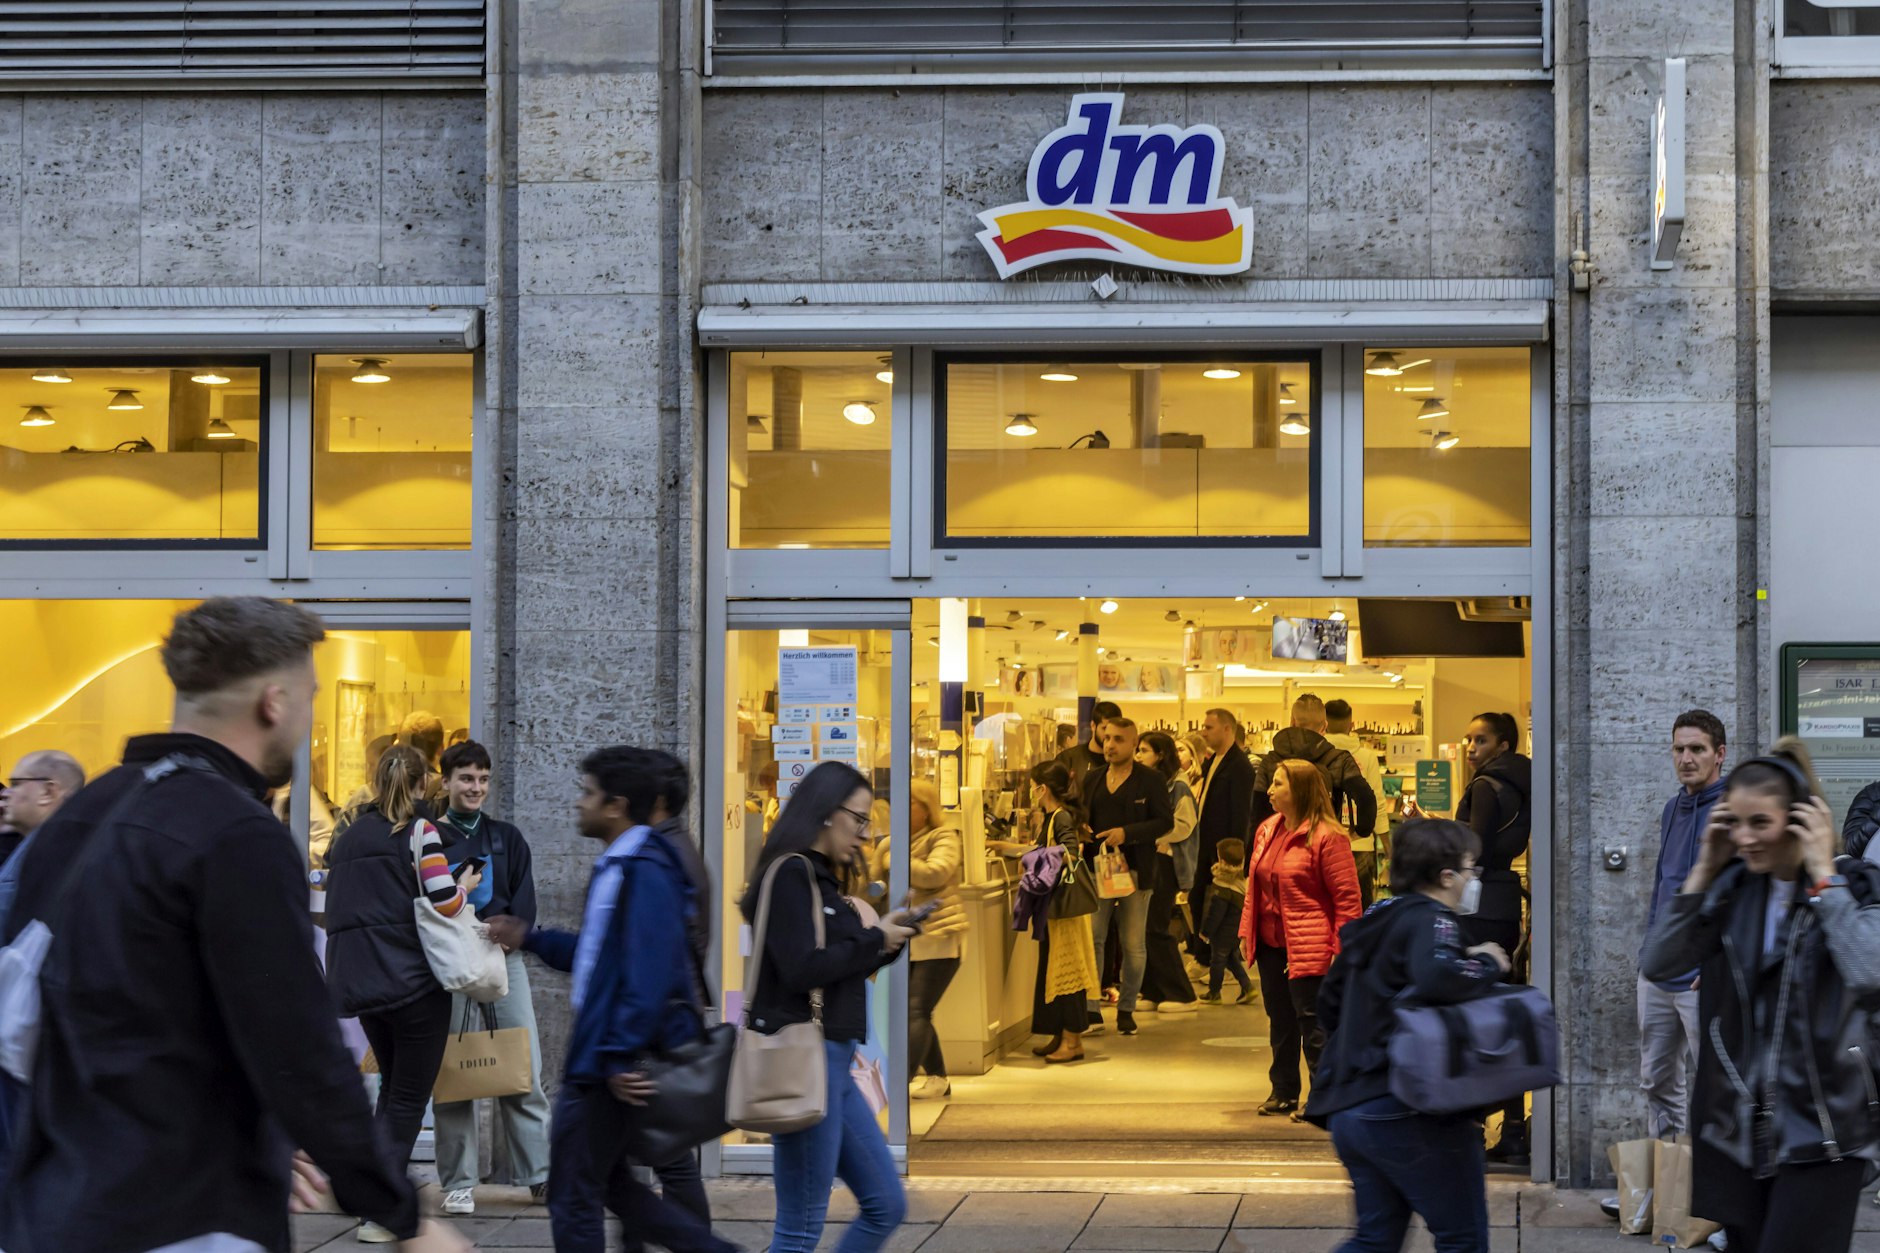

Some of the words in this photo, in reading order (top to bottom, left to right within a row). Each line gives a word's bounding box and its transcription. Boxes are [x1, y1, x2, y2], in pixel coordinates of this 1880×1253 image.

[1036, 102, 1216, 206] dm
[782, 651, 811, 660] Herzlich
[812, 651, 853, 659] willkommen
[1835, 678, 1863, 688] ISAR
